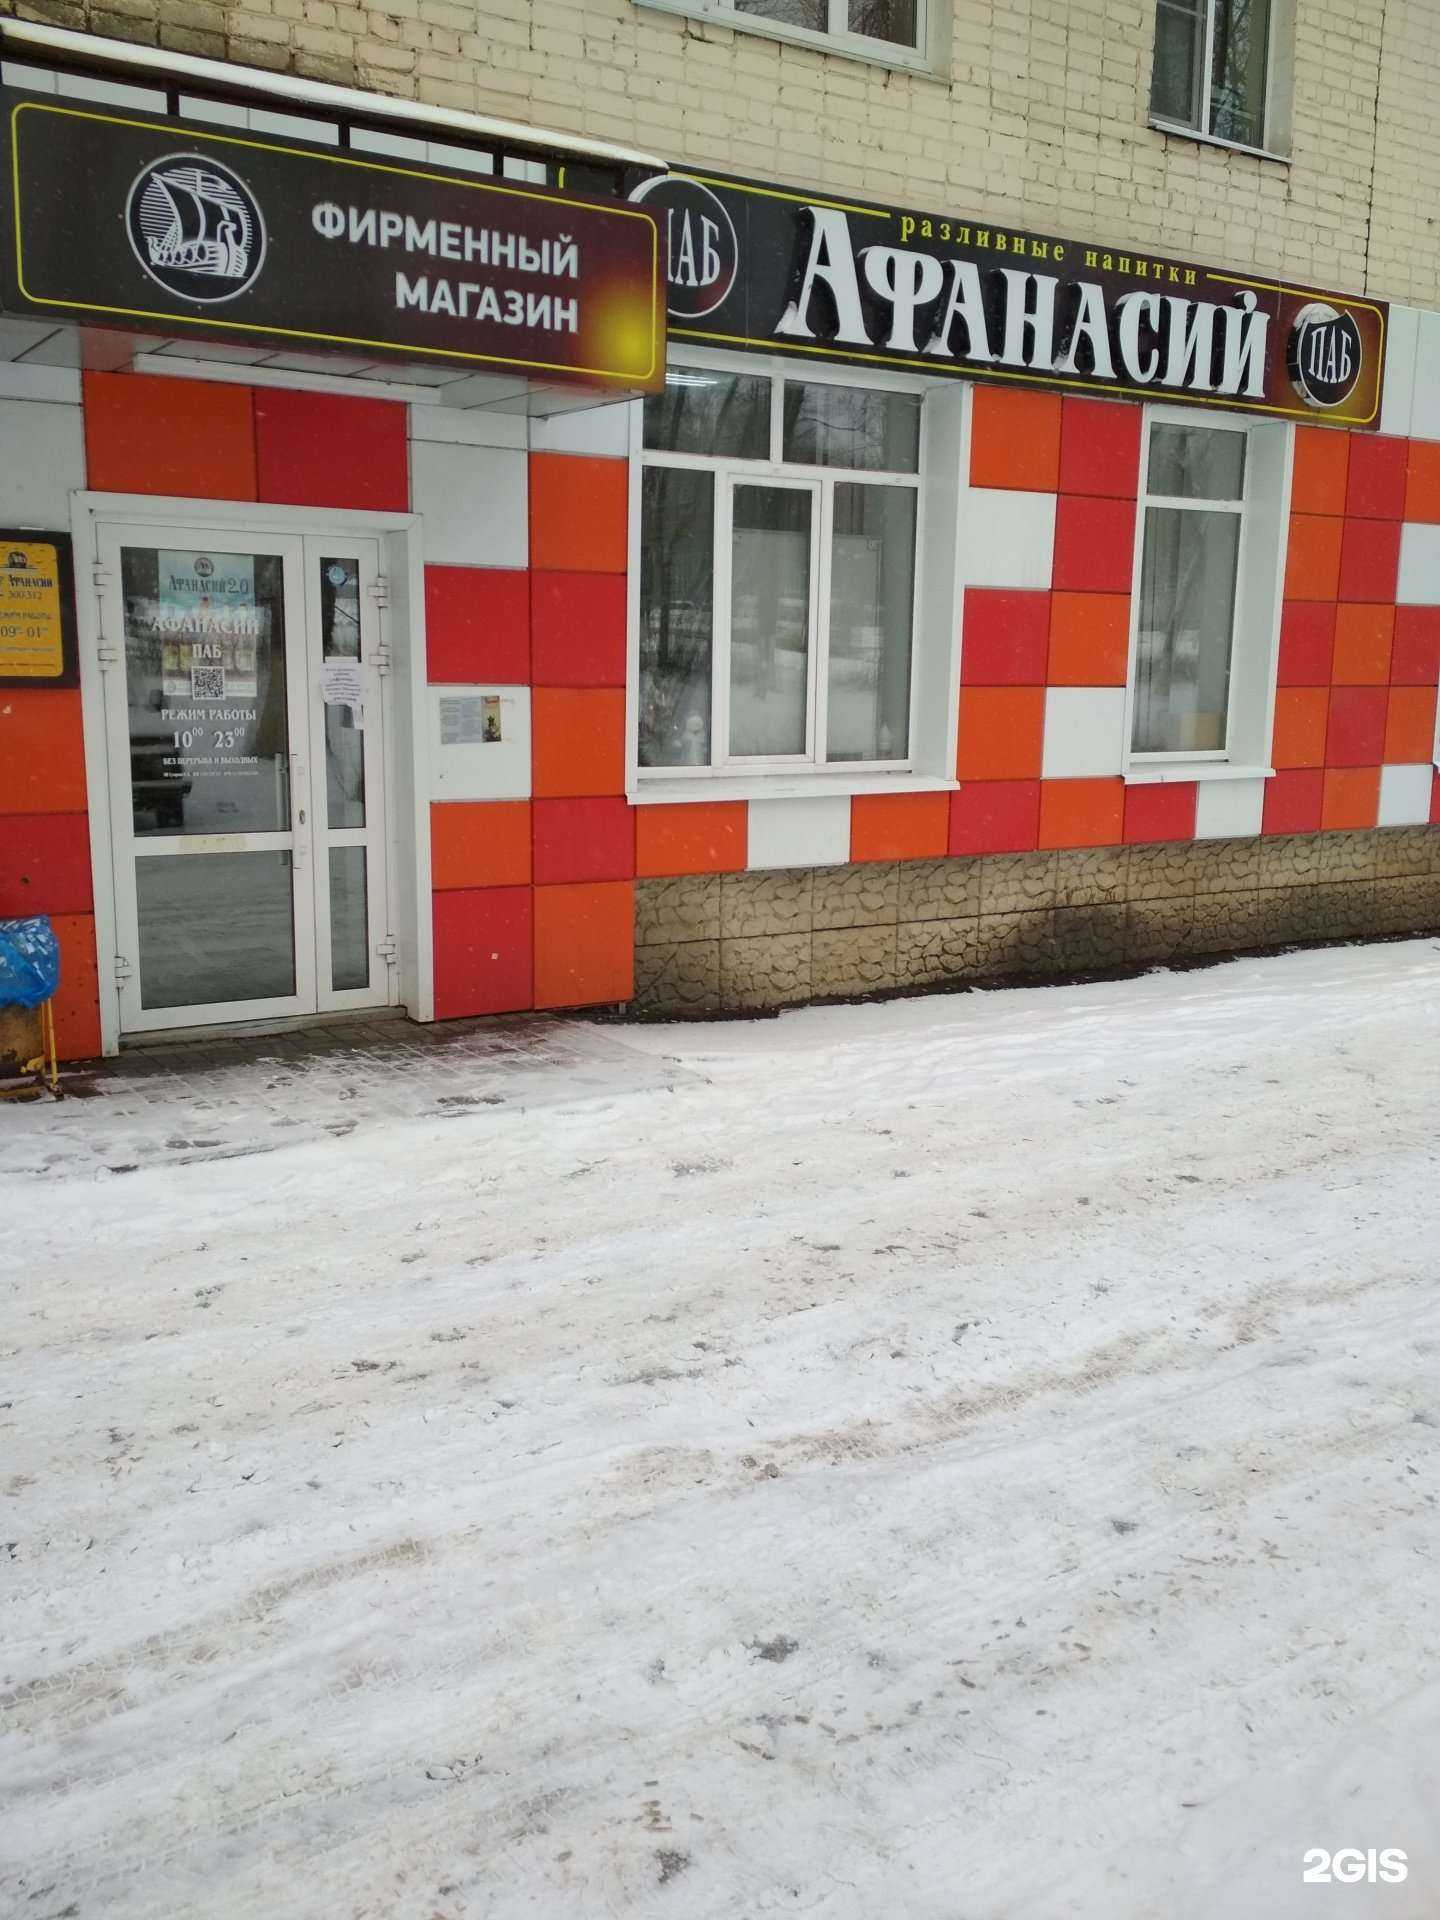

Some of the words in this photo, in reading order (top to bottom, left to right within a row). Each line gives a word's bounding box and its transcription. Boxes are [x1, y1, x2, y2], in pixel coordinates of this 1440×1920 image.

[311, 201, 579, 279] ФИРМЕННЫЙ
[900, 215, 1065, 260] разливные
[1085, 250, 1197, 285] напитки
[395, 271, 579, 334] МАГАЗИН
[775, 206, 1271, 398] АФАНАСИЙ
[1308, 325, 1352, 383] ПАБ
[192, 643, 222, 659] ПАБ
[161, 708, 206, 721] РЕЖИМ
[208, 708, 257, 721] РАБОТЫ
